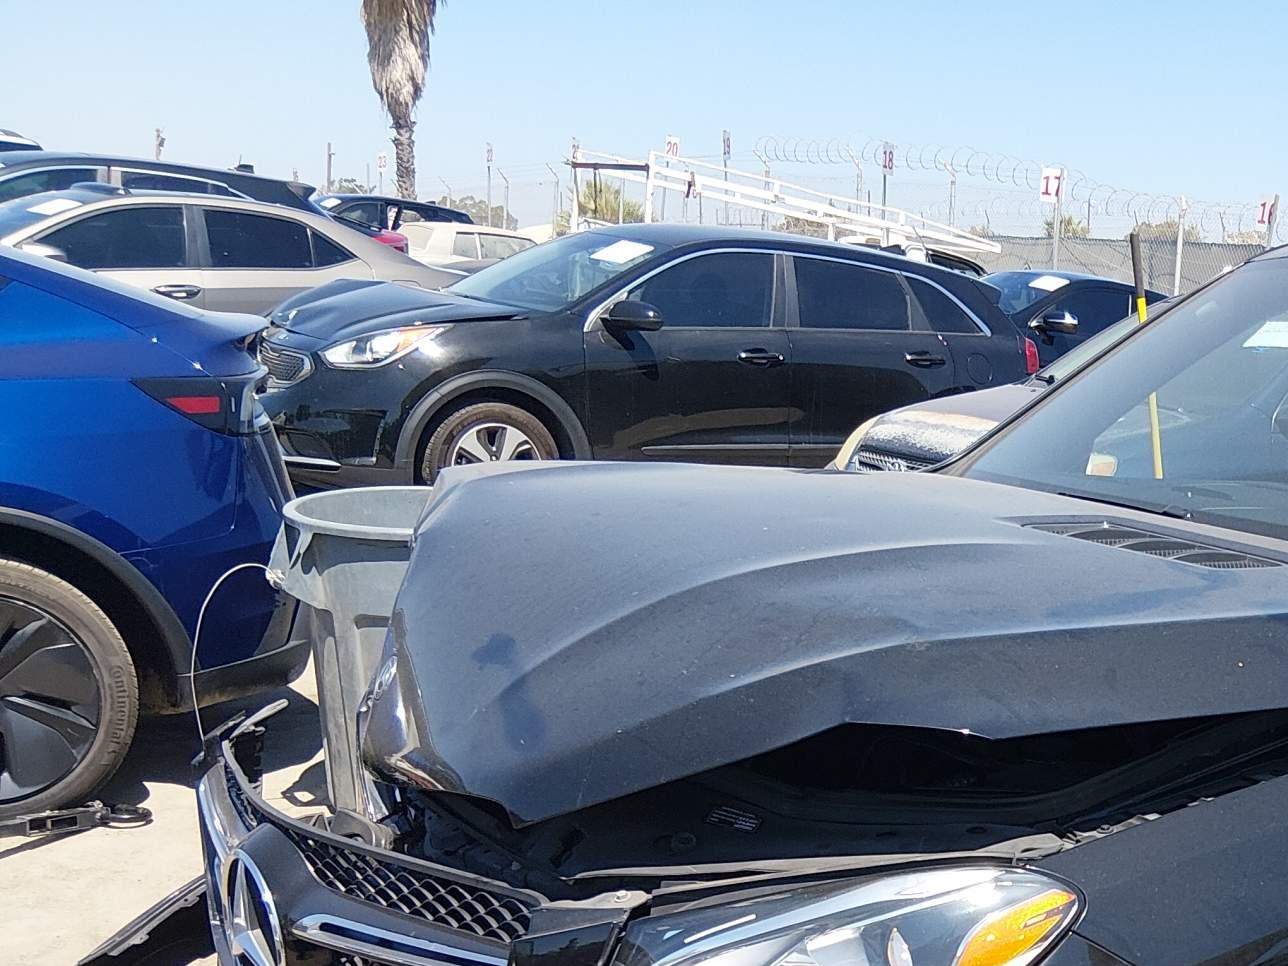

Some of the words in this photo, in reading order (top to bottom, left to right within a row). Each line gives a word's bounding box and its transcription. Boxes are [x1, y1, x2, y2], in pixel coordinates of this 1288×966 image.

[665, 140, 678, 157] 20
[722, 136, 731, 156] 19
[882, 150, 894, 170] 18
[1041, 175, 1061, 197] 17
